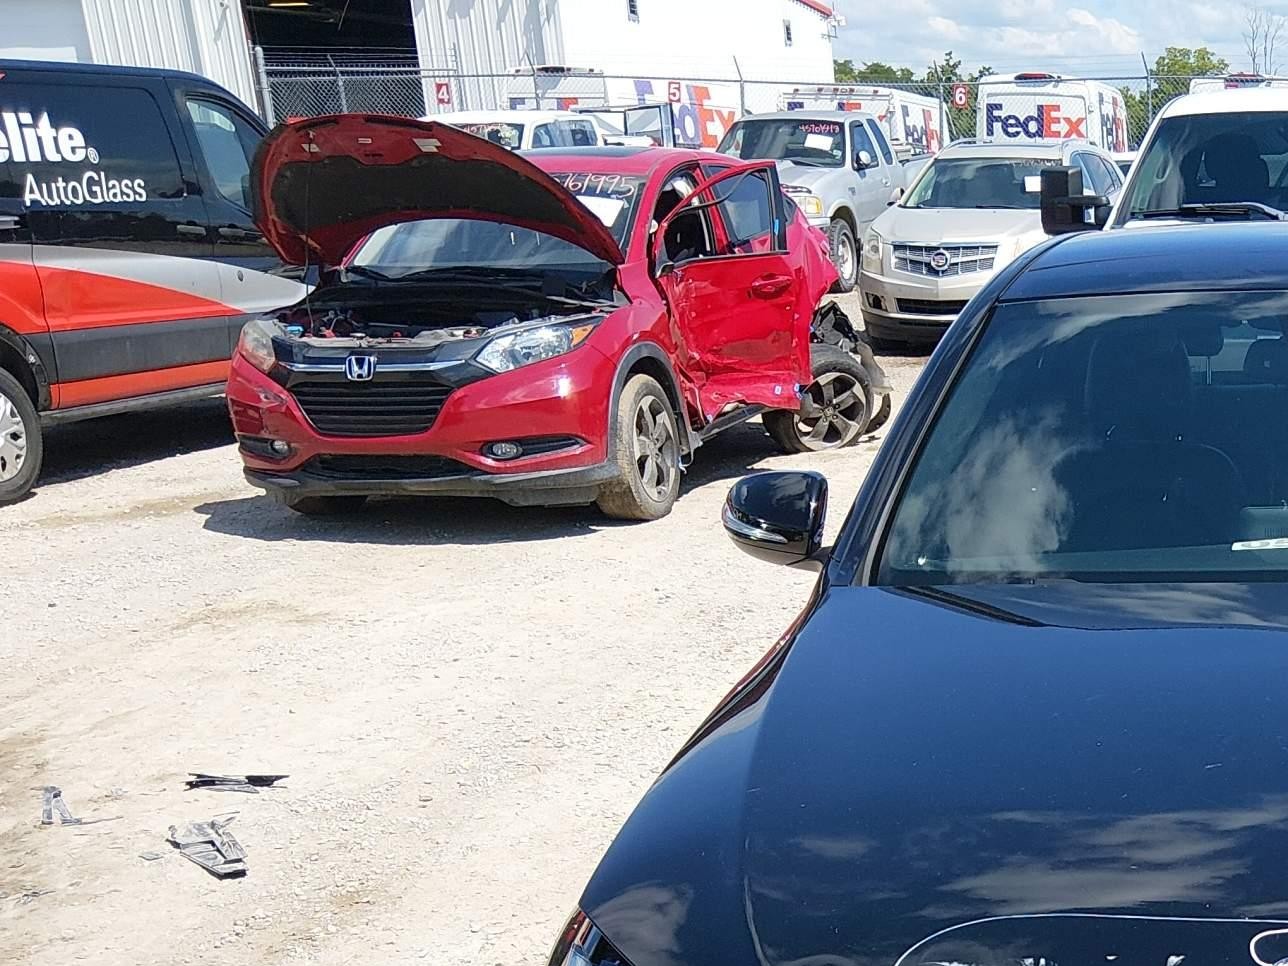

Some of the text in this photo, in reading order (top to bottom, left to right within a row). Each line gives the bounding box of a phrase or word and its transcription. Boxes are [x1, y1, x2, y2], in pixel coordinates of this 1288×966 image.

[438, 85, 450, 102] 4
[669, 83, 680, 102] 5
[955, 87, 966, 105] 6
[986, 103, 1088, 139] FedEx
[24, 170, 147, 207] AutoGlass
